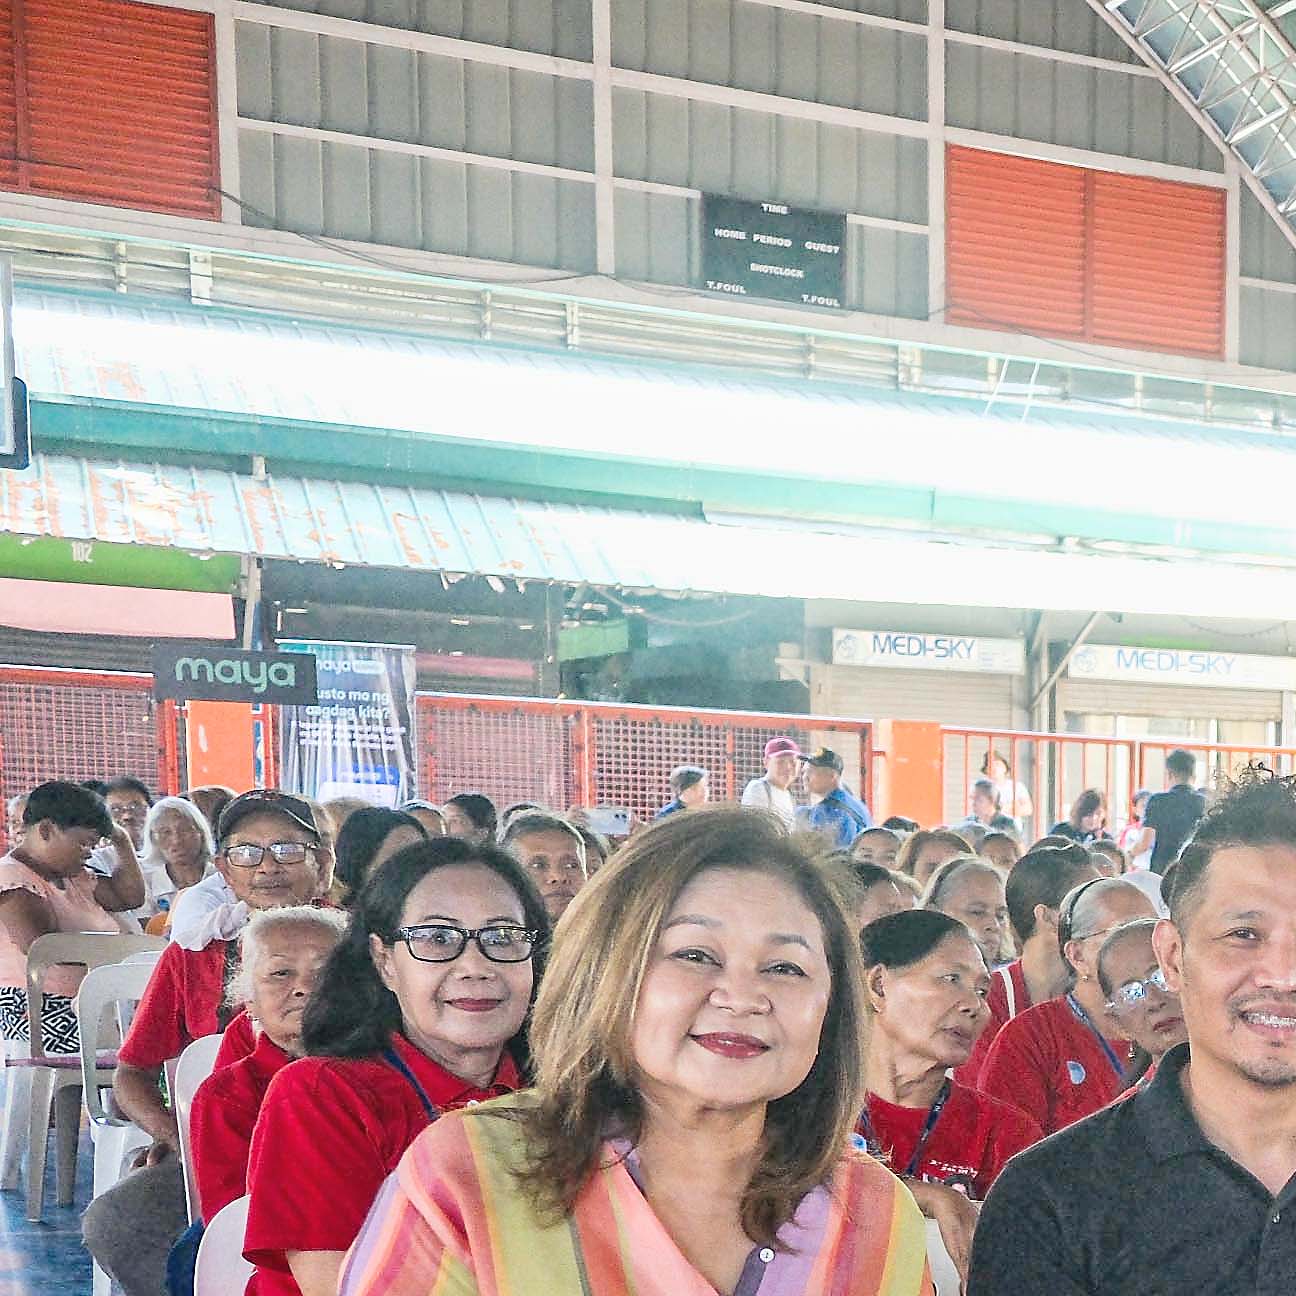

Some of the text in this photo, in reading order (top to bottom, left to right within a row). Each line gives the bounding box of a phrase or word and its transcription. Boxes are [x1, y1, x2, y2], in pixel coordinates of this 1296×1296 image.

[761, 203, 788, 215] TIME
[714, 228, 840, 254] HOME PERIOD GUEST
[707, 280, 746, 294] T.FOUL
[802, 294, 840, 307] T.FOUL
[872, 633, 975, 659] MEDI-SKY
[317, 659, 351, 674] aya
[1117, 648, 1236, 674] MEDI-SKY
[175, 657, 296, 693] maya
[317, 688, 346, 700] usto
[348, 690, 370, 701] mo
